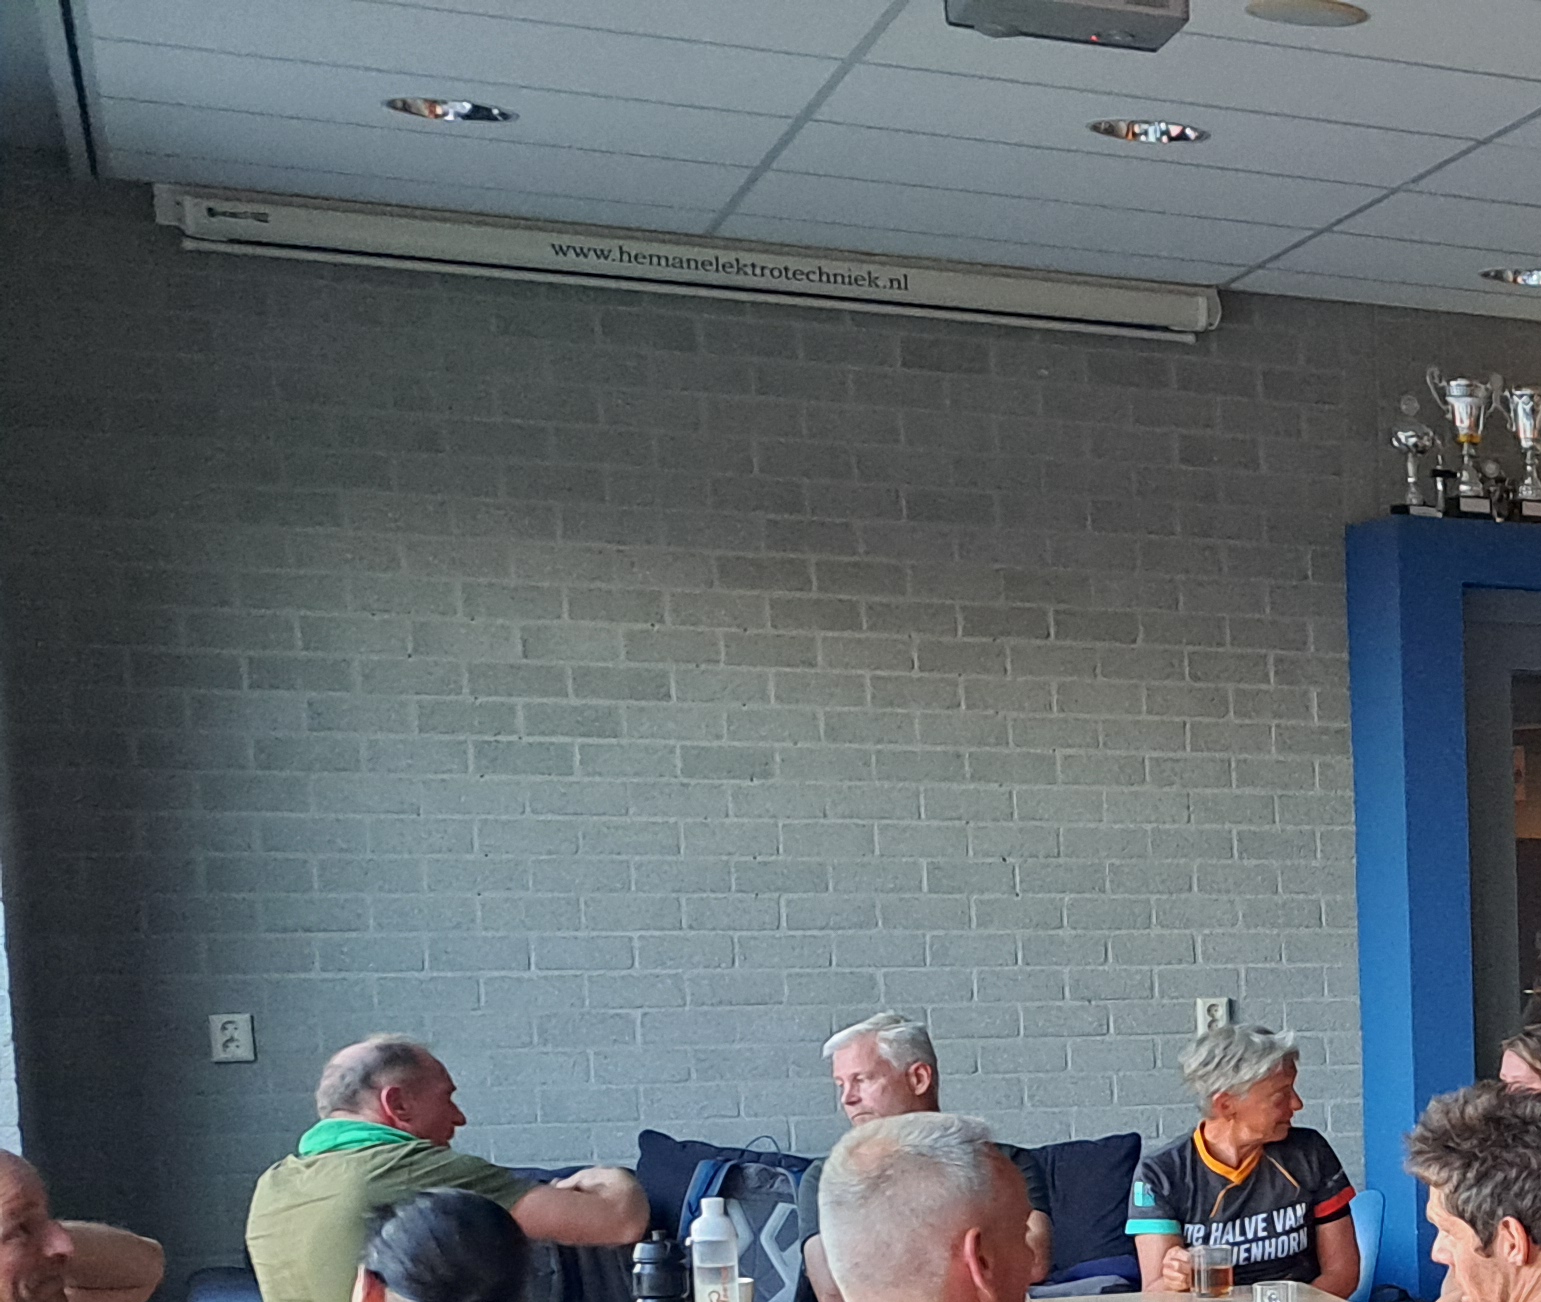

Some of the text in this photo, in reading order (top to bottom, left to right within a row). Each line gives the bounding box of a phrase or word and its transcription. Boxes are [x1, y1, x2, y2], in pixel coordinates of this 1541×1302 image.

[551, 242, 909, 291] www.hemanelektrotechniek.nl
[1209, 1213, 1269, 1247] HALVE
[1272, 1202, 1307, 1233] VAN
